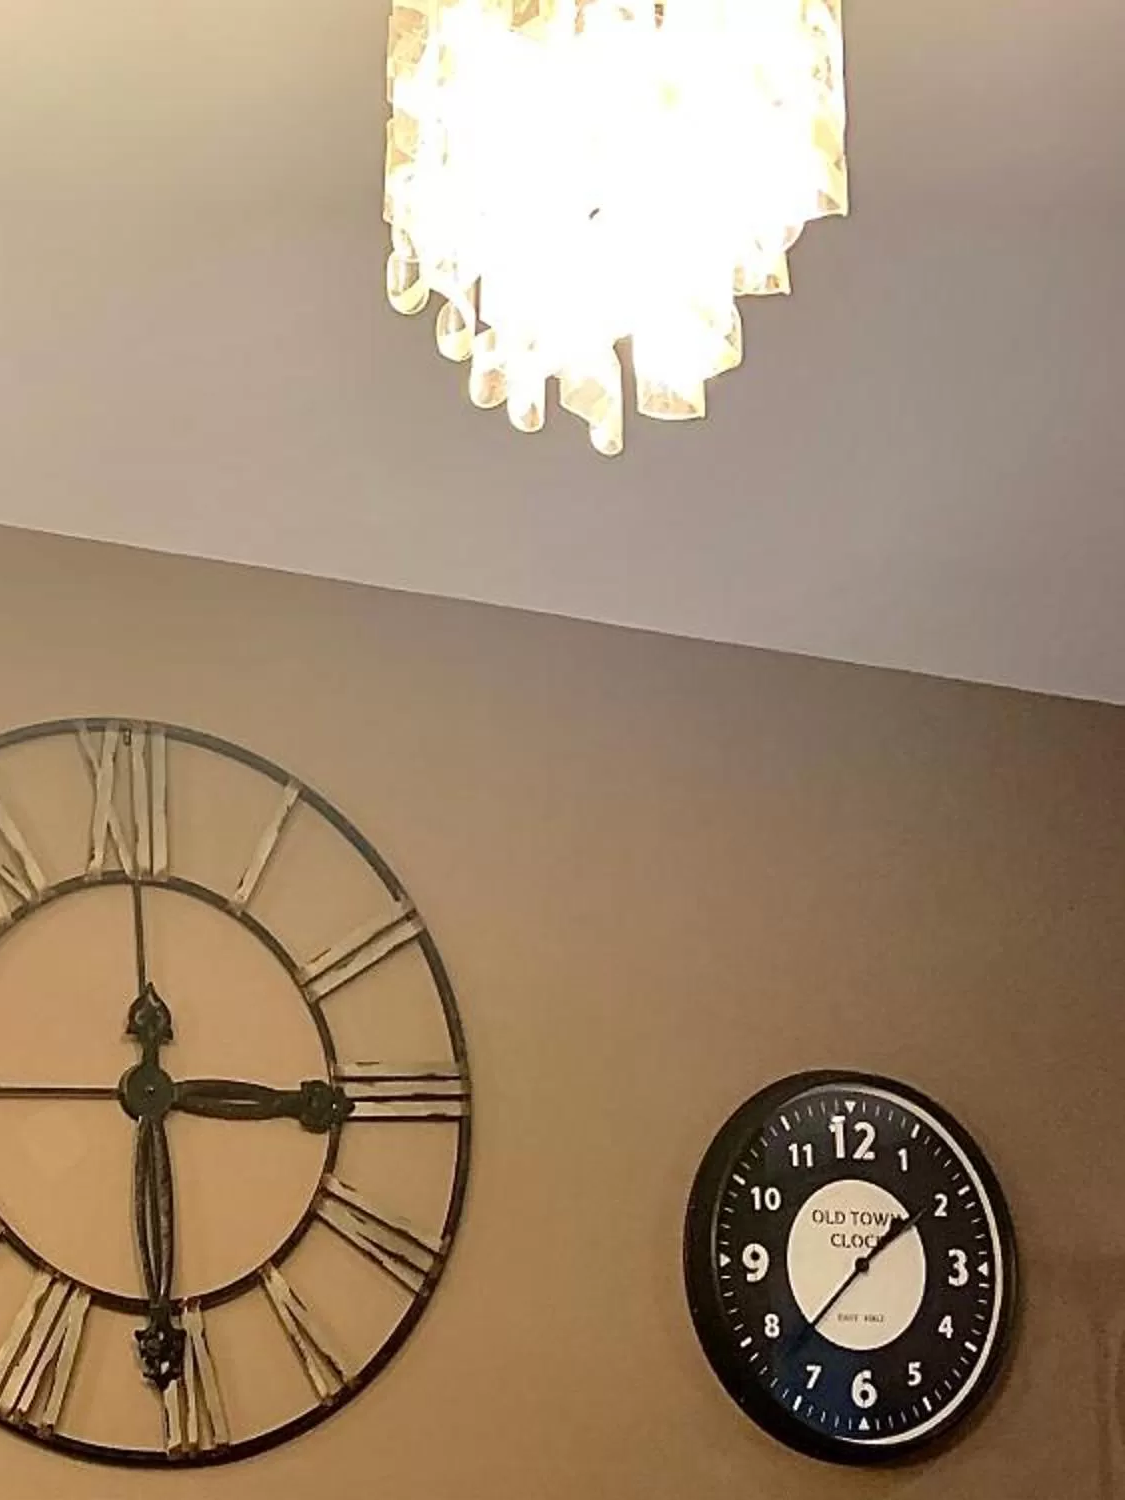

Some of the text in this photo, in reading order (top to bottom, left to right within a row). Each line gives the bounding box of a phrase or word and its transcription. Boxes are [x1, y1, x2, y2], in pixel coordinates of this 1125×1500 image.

[829, 1115, 876, 1161] 12
[788, 1143, 814, 1168] 11
[898, 1148, 908, 1172] 1
[751, 1187, 782, 1210] 10
[934, 1194, 948, 1217] 2
[812, 1209, 846, 1225] OLD
[742, 1243, 769, 1282] 9
[947, 1249, 969, 1286] 3
[764, 1314, 780, 1338] 8
[937, 1315, 954, 1339] 4
[805, 1365, 823, 1389] 7
[907, 1362, 922, 1386] 5
[851, 1370, 878, 1409] 6
